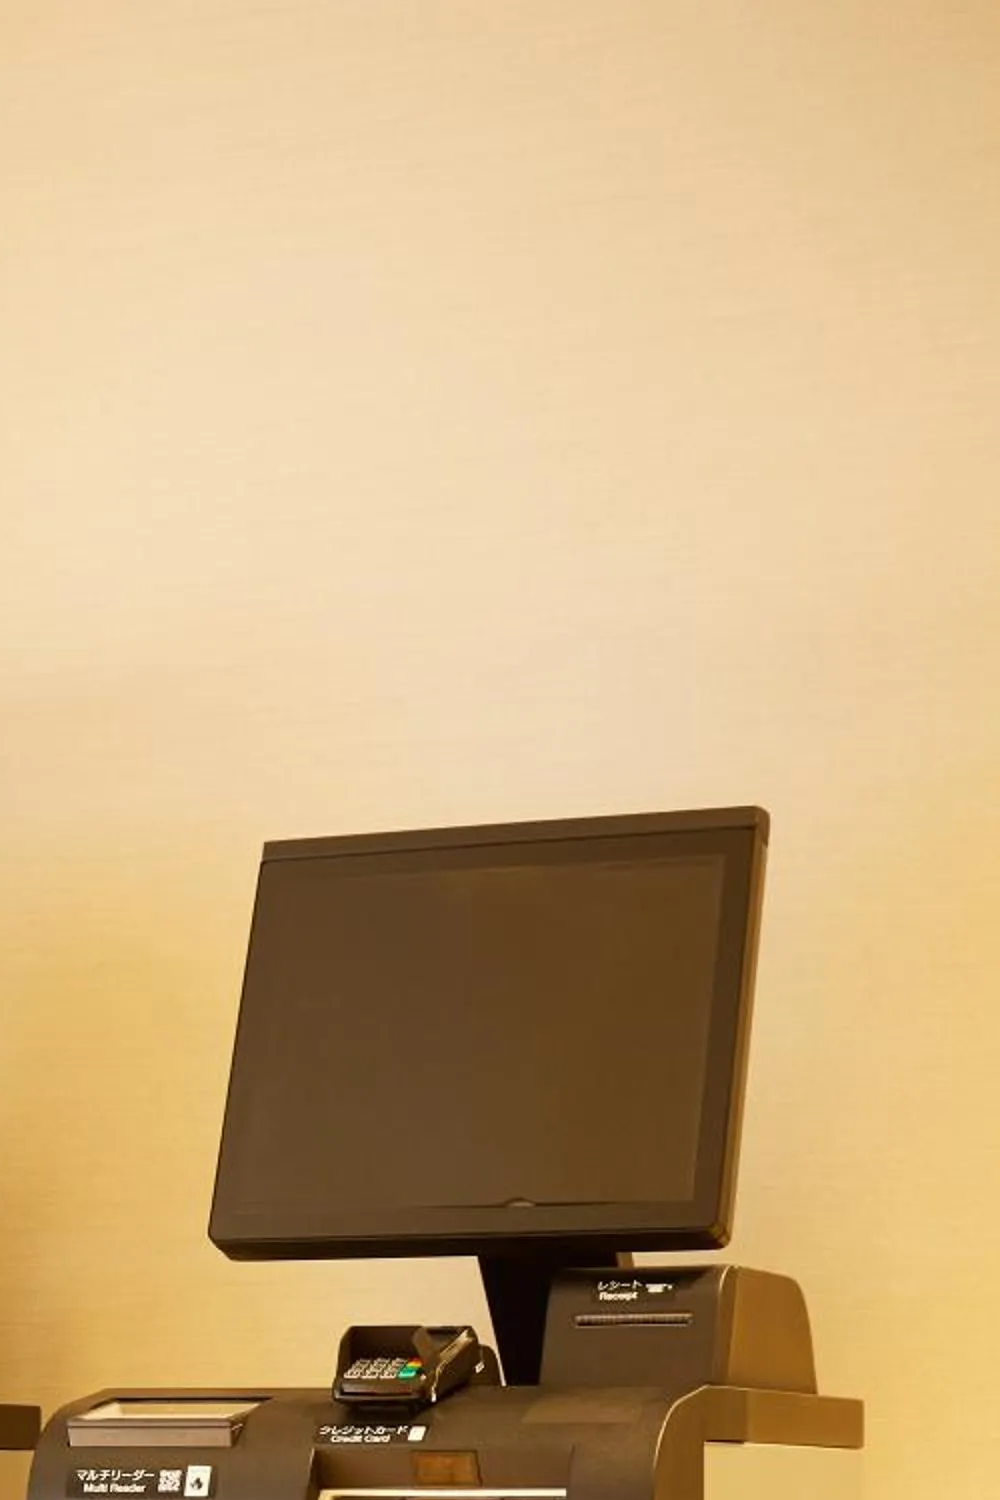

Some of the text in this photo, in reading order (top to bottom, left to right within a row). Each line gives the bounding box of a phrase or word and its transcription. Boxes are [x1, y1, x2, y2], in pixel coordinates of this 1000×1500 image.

[76, 1469, 155, 1481] マルチリーダー
